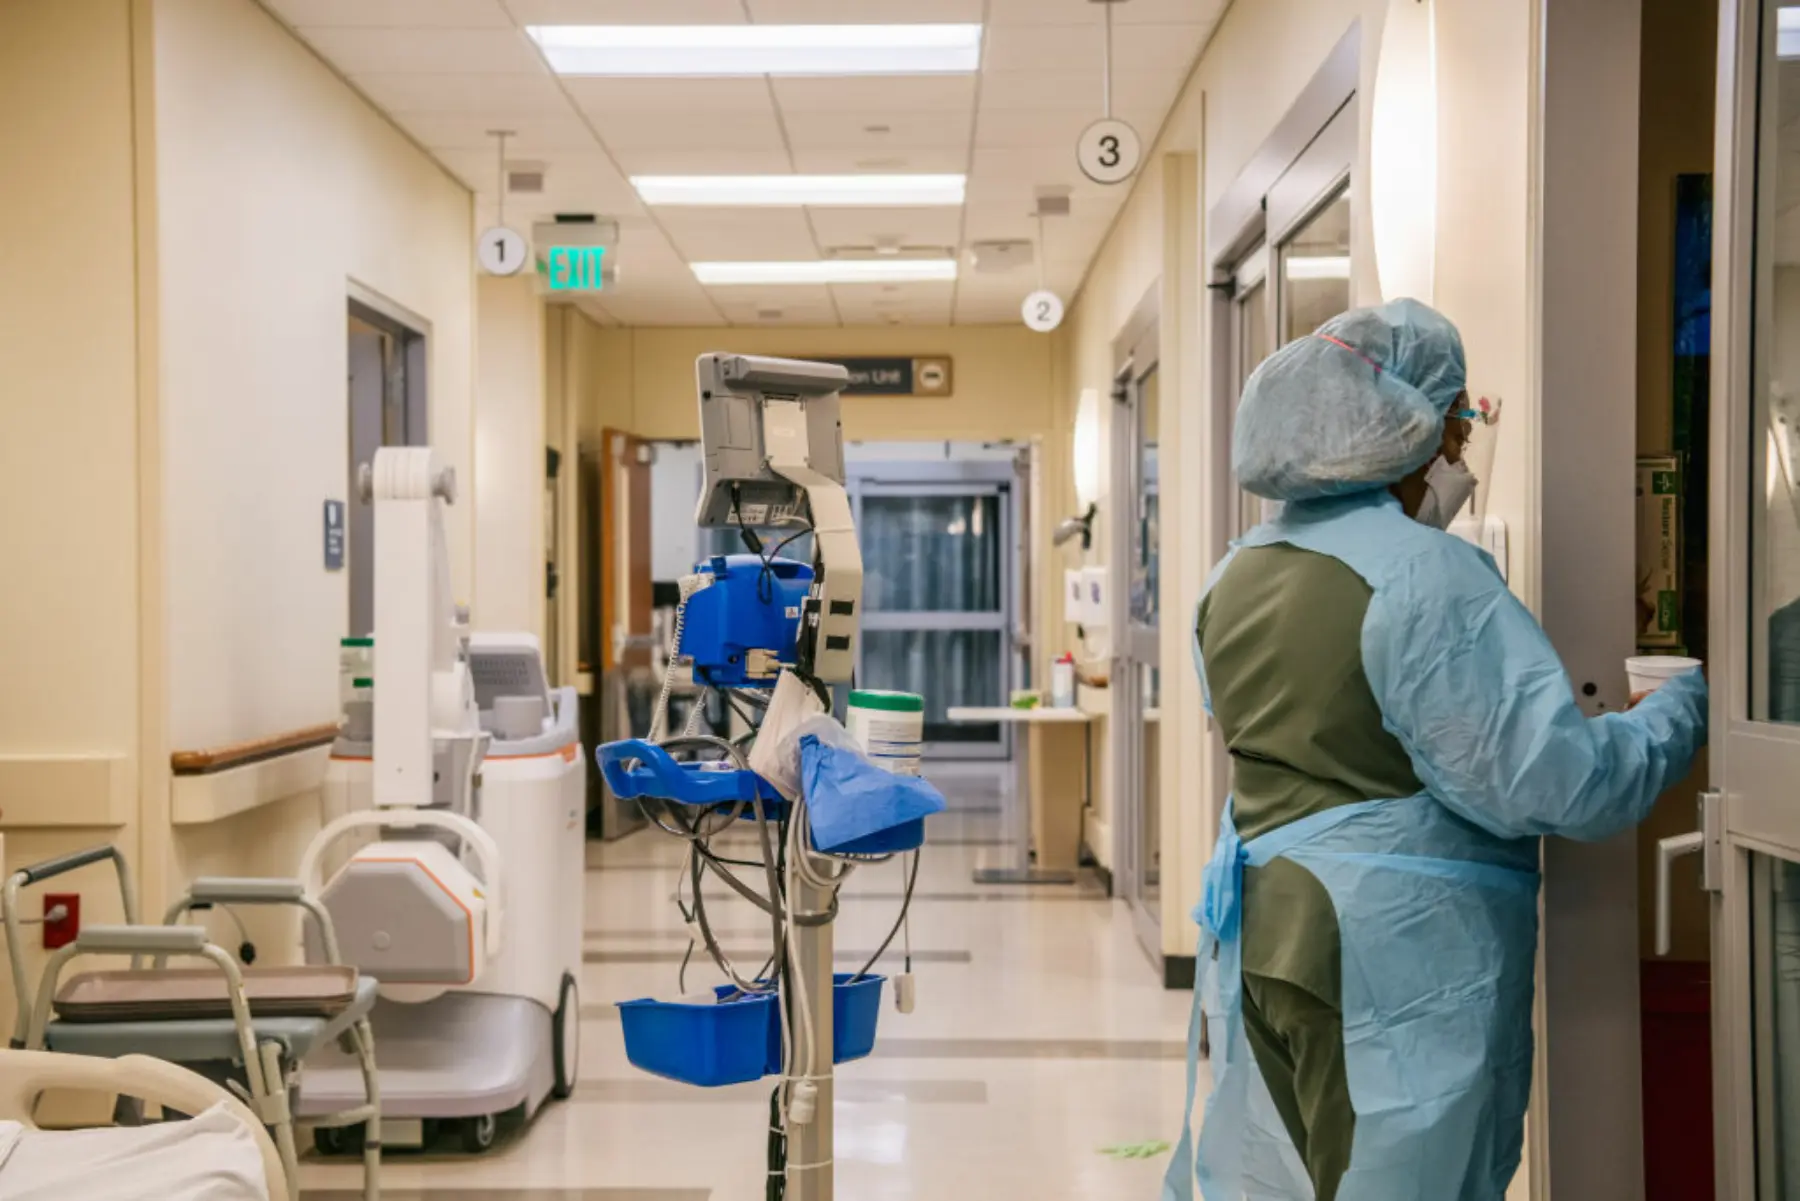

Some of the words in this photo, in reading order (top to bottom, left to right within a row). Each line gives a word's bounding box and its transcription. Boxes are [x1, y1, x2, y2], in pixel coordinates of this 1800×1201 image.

[1098, 135, 1120, 167] 3
[493, 239, 505, 263] 1
[549, 246, 605, 290] EXIT
[1036, 301, 1051, 322] 2
